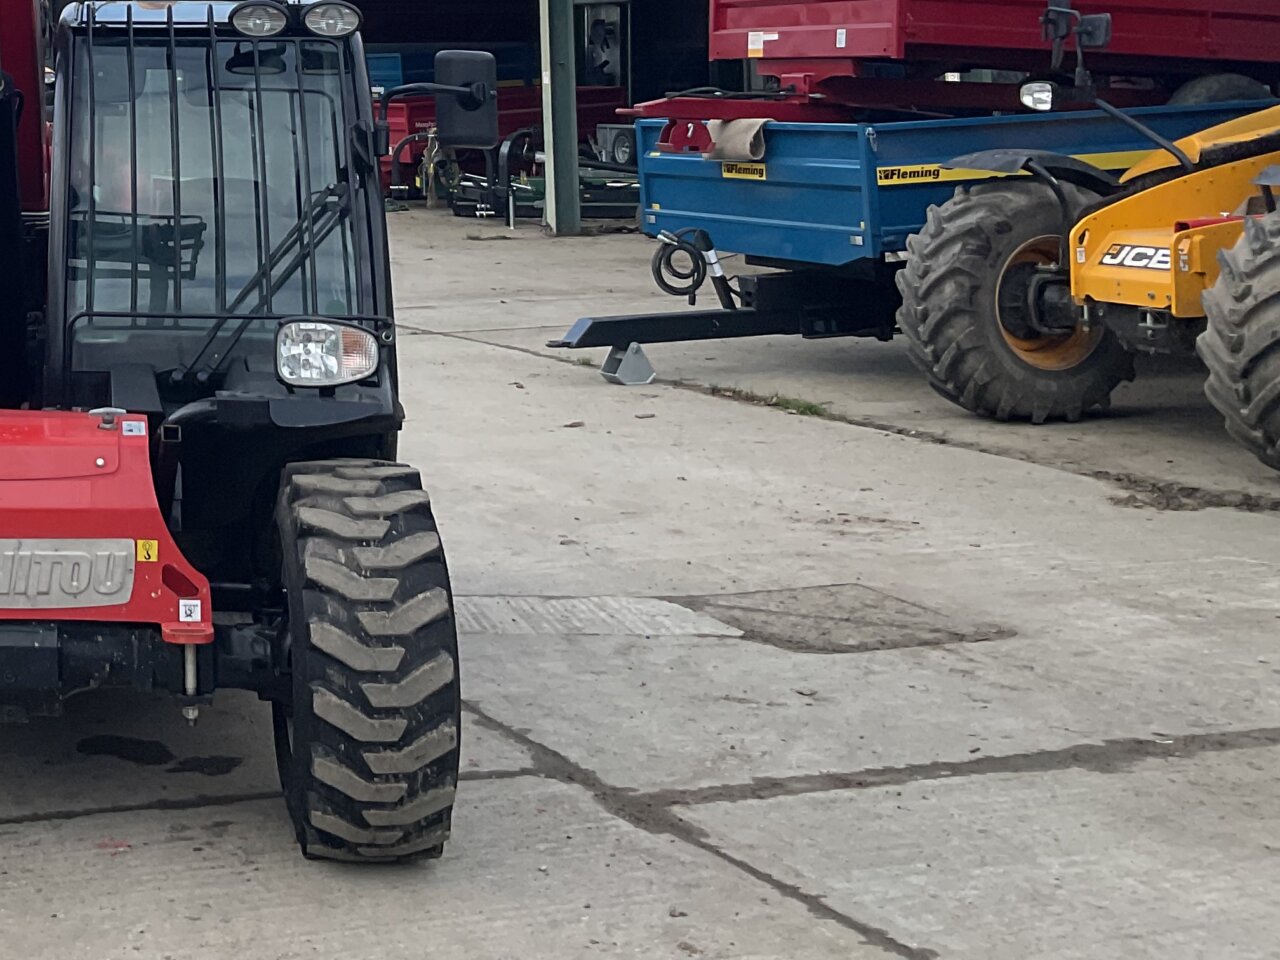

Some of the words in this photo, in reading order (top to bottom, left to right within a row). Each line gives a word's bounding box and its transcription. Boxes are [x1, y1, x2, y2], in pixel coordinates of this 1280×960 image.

[730, 163, 764, 178] Fleming
[889, 166, 941, 180] Fleming
[1101, 245, 1171, 269] JCB
